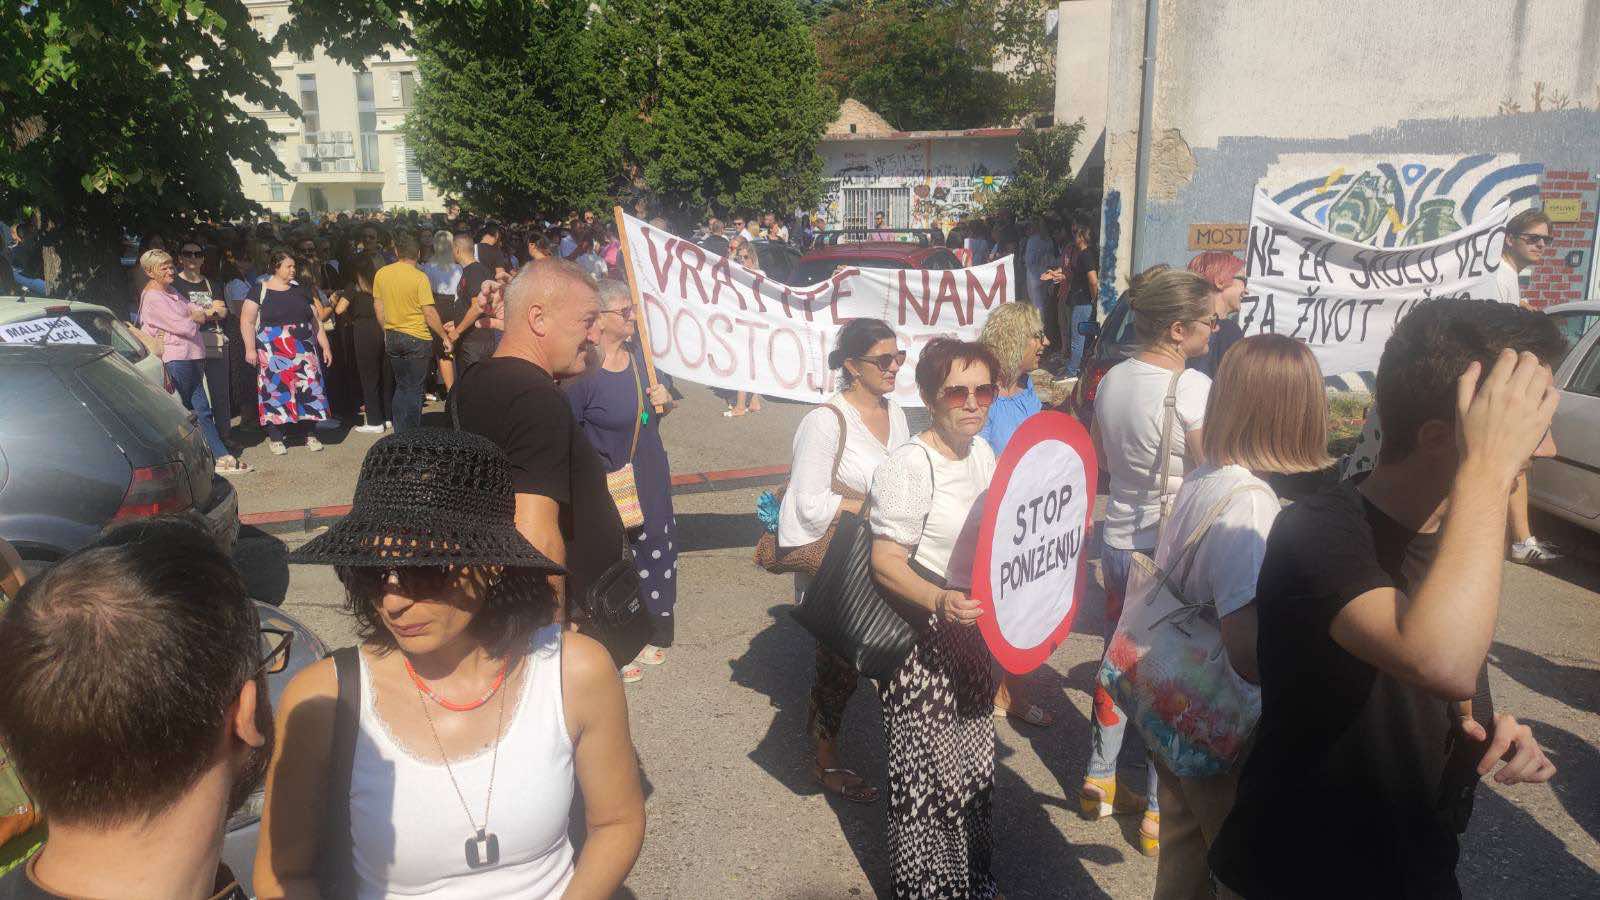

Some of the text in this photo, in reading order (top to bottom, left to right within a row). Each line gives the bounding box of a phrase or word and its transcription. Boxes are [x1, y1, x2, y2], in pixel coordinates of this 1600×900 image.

[1197, 228, 1248, 244] MOST
[1246, 226, 1287, 278] NE
[1299, 236, 1337, 284] ZA
[640, 227, 1007, 327] VRATITE NAM
[5, 323, 45, 338] MALA
[1242, 294, 1275, 337] ZA
[1290, 286, 1384, 344] ŽIVOT
[1013, 485, 1072, 546] STOP
[1000, 526, 1081, 600] PONIŽENJU
